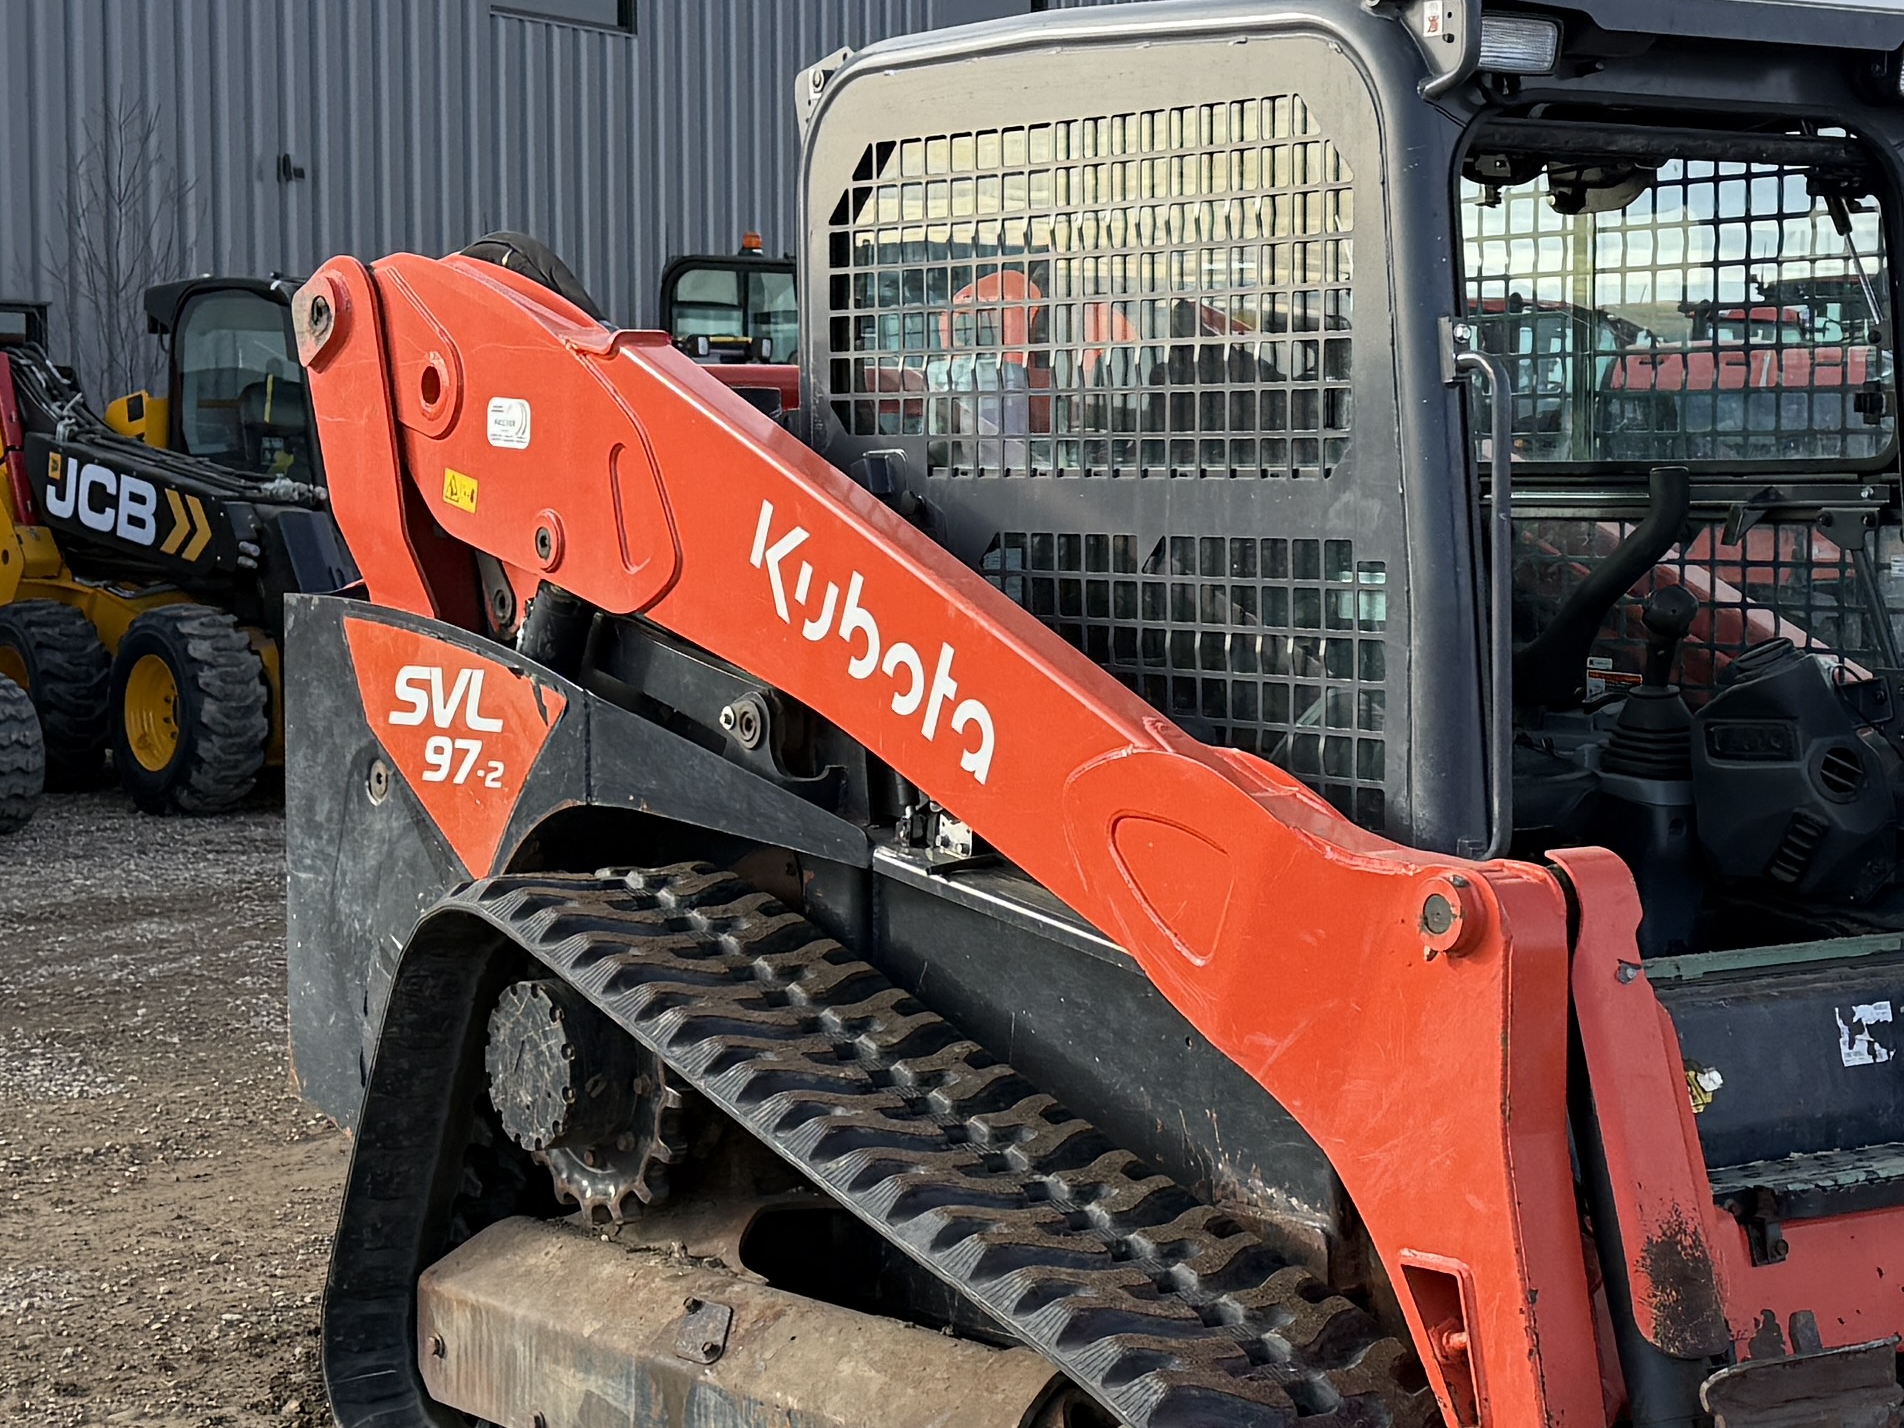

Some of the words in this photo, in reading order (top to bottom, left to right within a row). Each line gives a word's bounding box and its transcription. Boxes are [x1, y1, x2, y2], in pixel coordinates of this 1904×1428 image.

[46, 457, 157, 546] JCB
[749, 498, 995, 785] Kubota
[388, 665, 503, 732] SVL
[421, 735, 505, 788] 97-2
